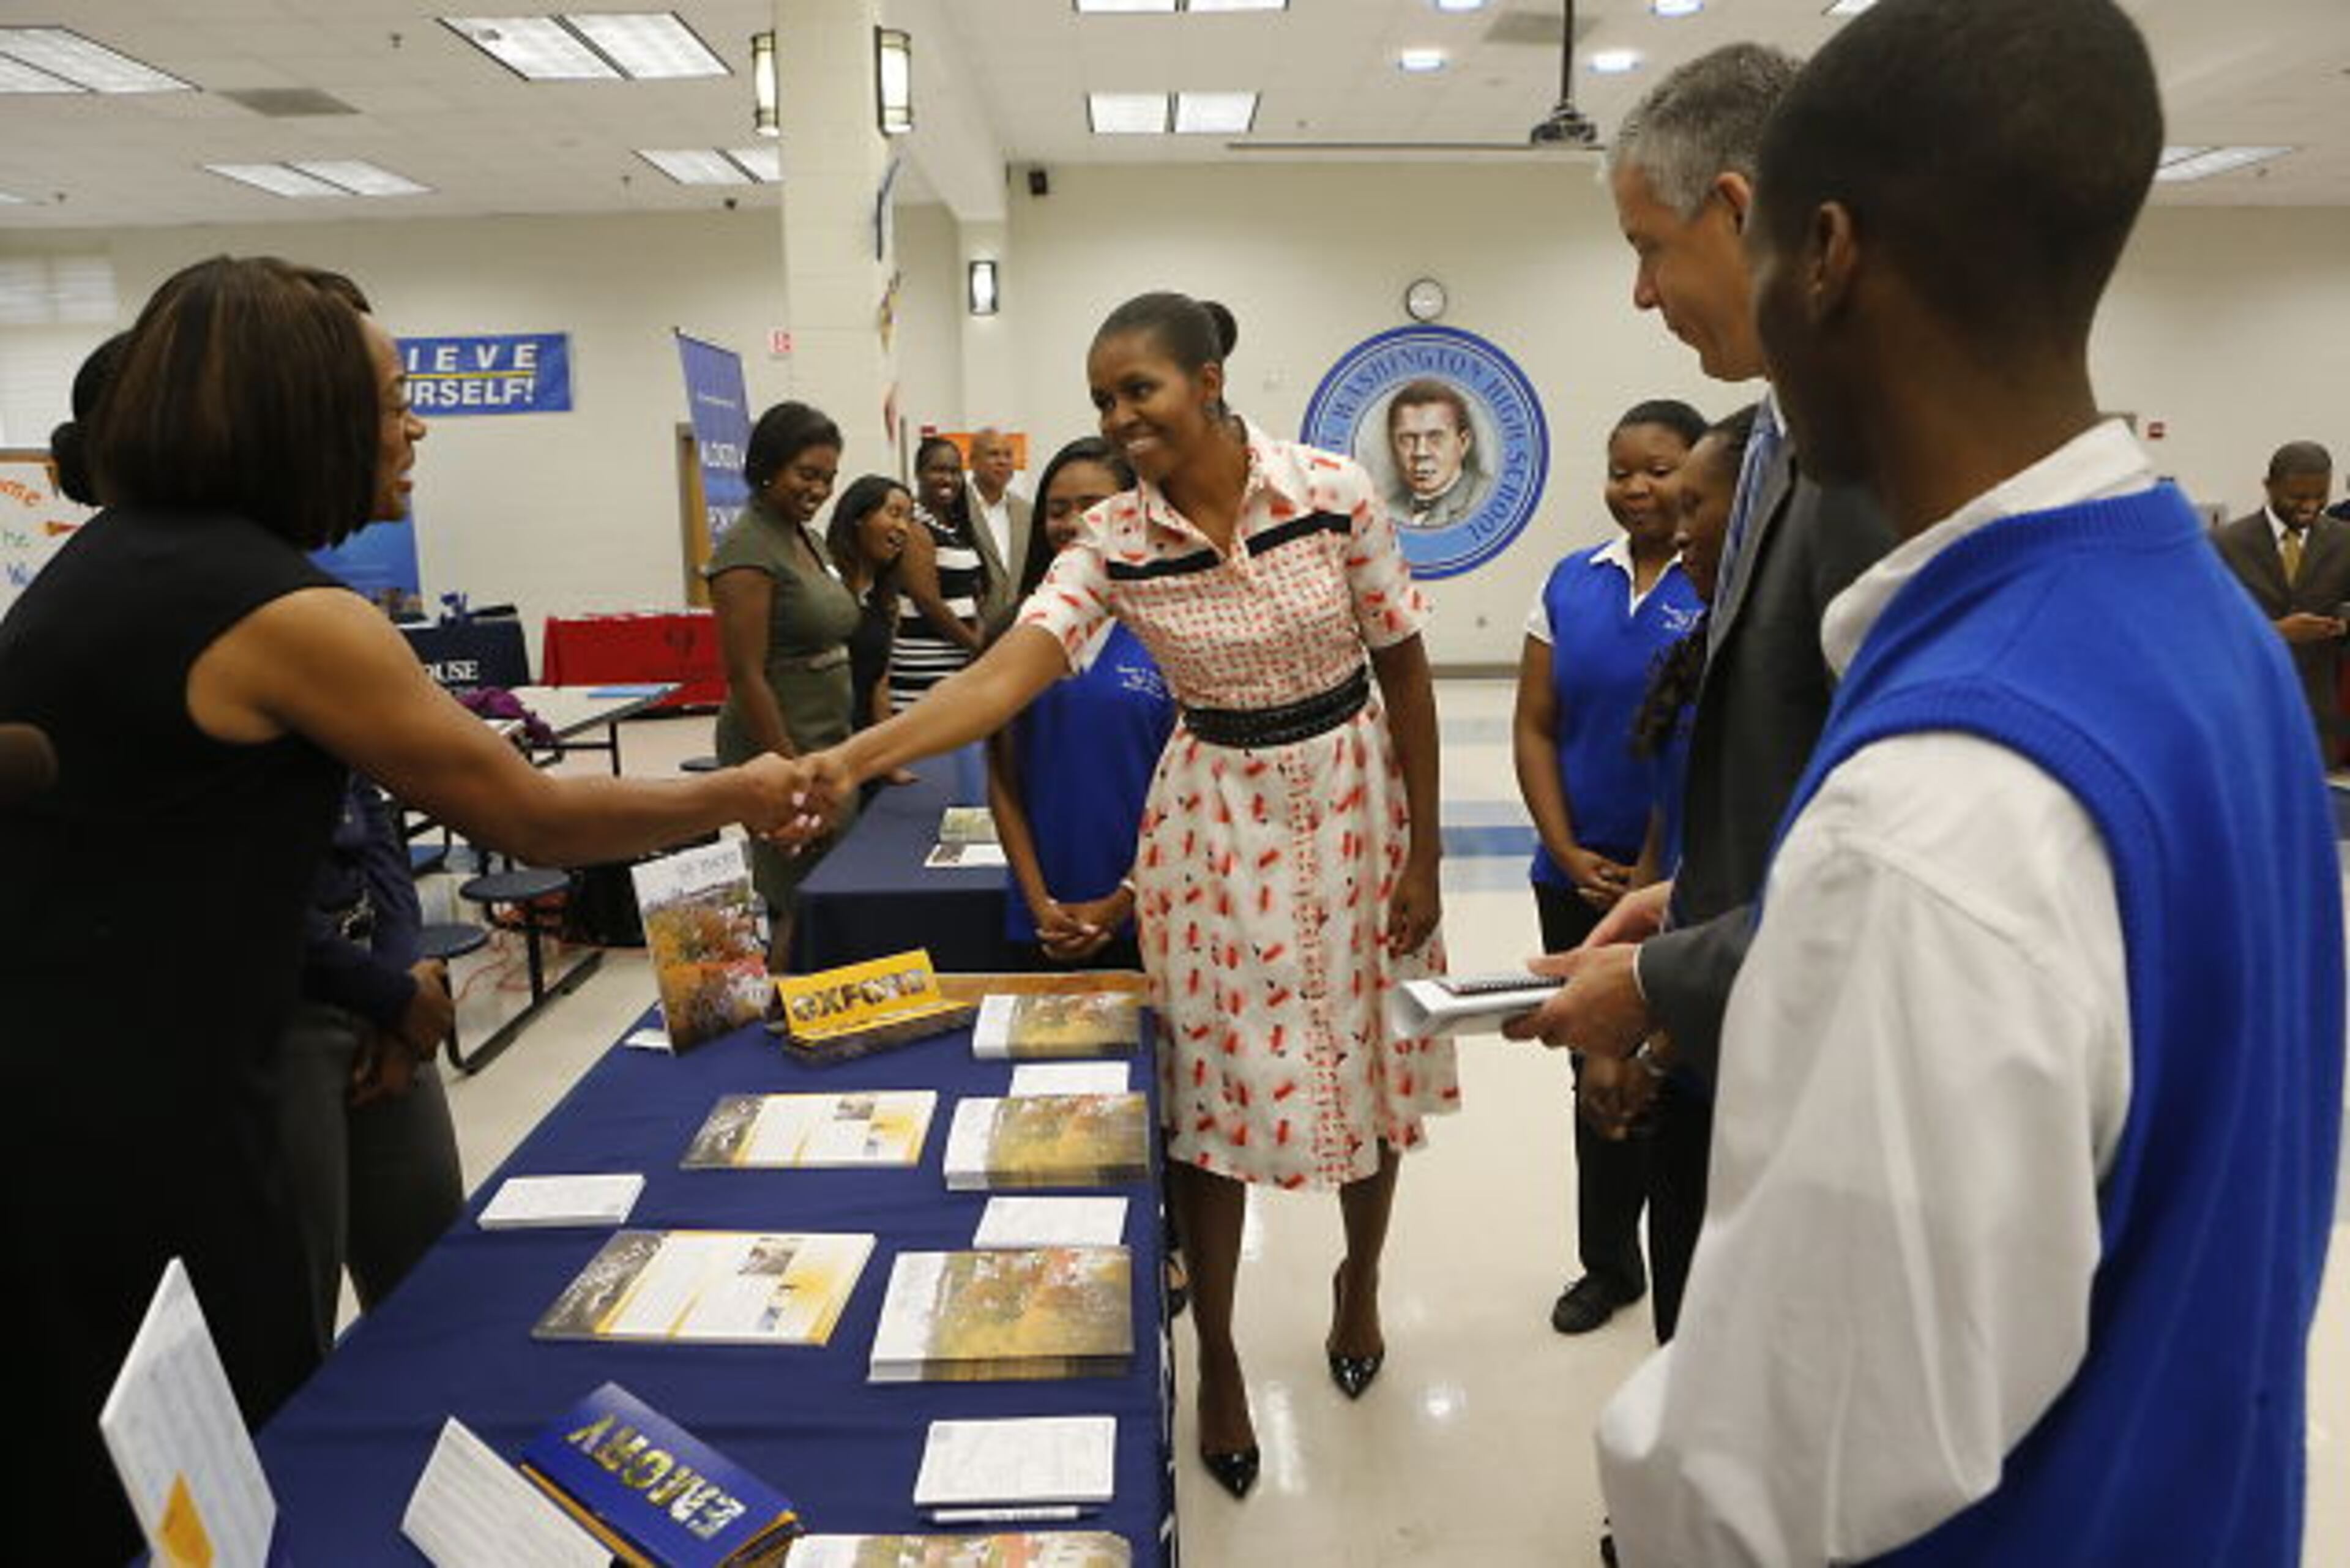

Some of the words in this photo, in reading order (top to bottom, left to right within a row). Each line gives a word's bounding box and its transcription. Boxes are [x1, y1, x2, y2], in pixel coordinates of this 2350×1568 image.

[1331, 348, 1484, 420] WASHINGTON
[1482, 378, 1525, 442] HIGH
[1468, 451, 1528, 542] SCHOOL
[793, 969, 927, 1021] OXFORD
[564, 1415, 747, 1540] EMORY
